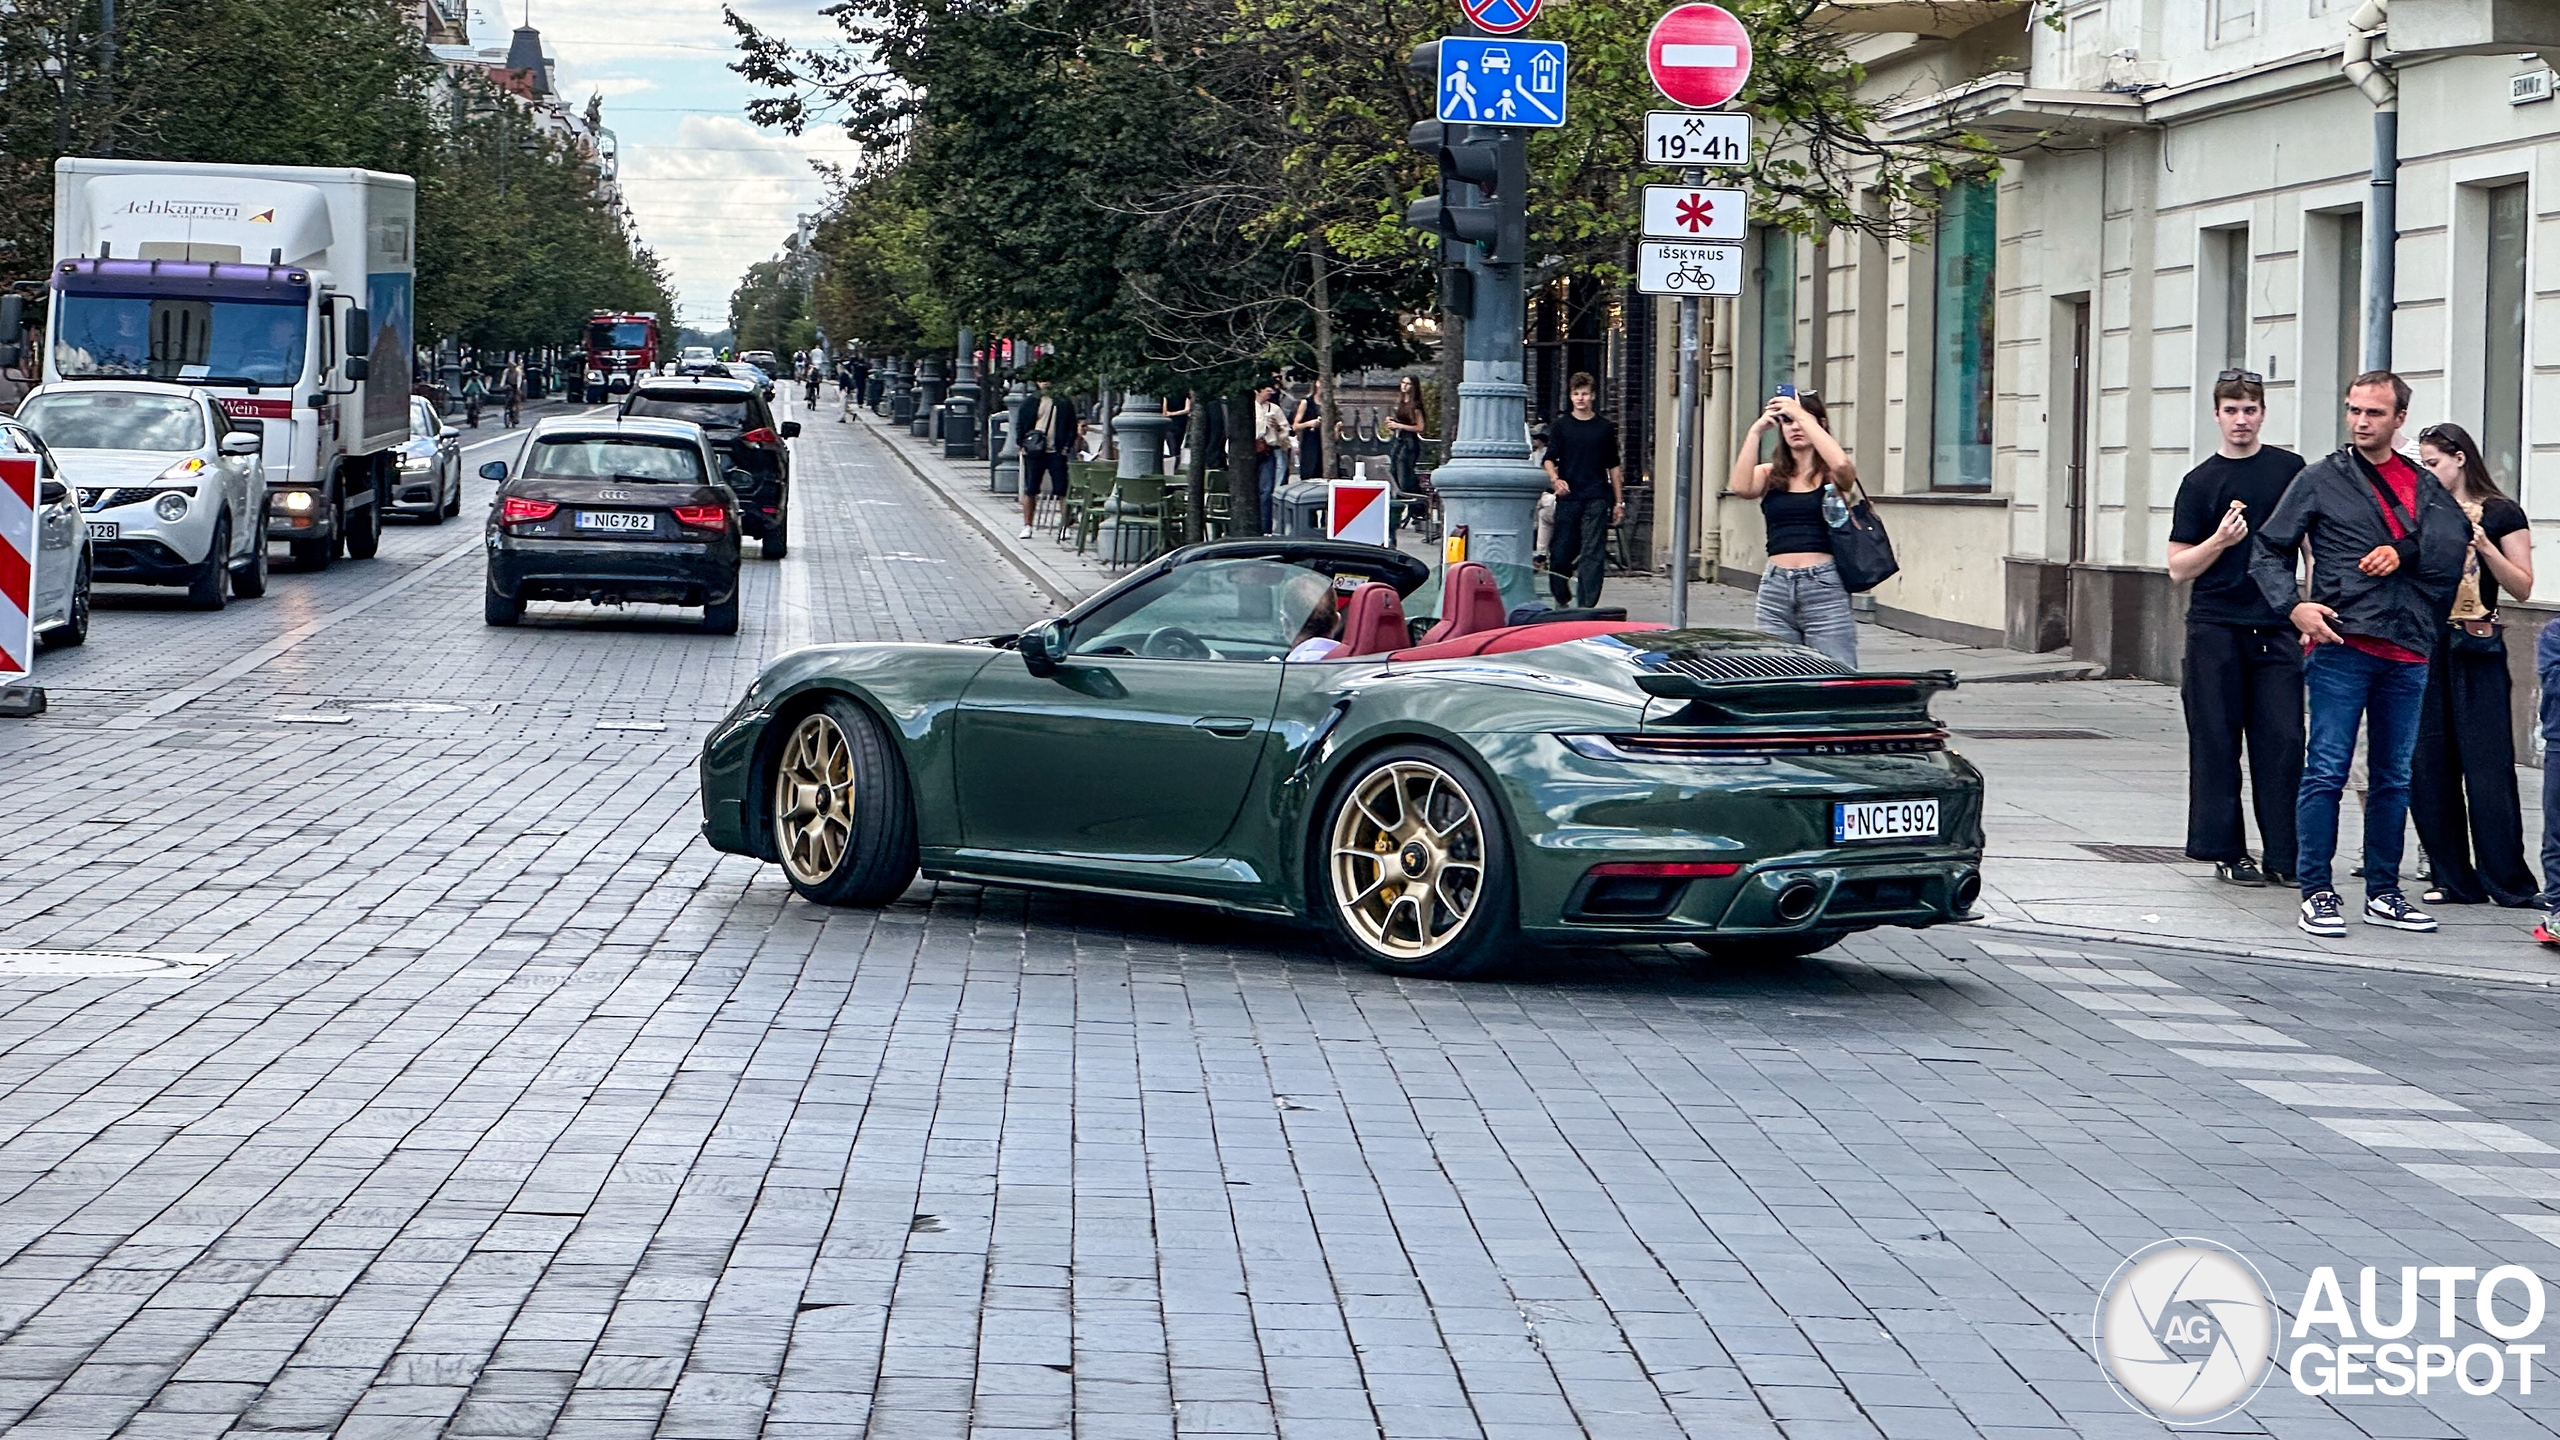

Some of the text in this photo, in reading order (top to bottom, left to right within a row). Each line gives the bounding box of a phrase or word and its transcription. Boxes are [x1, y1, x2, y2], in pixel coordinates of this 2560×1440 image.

[1657, 135, 1739, 160] 19-4h
[113, 200, 239, 217] Achkarren
[1659, 245, 1724, 261] IŠSKYRUS
[221, 401, 259, 415] Wein
[595, 514, 649, 528] NIG782
[90, 525, 114, 537] 128
[1858, 804, 1935, 835] NCE992
